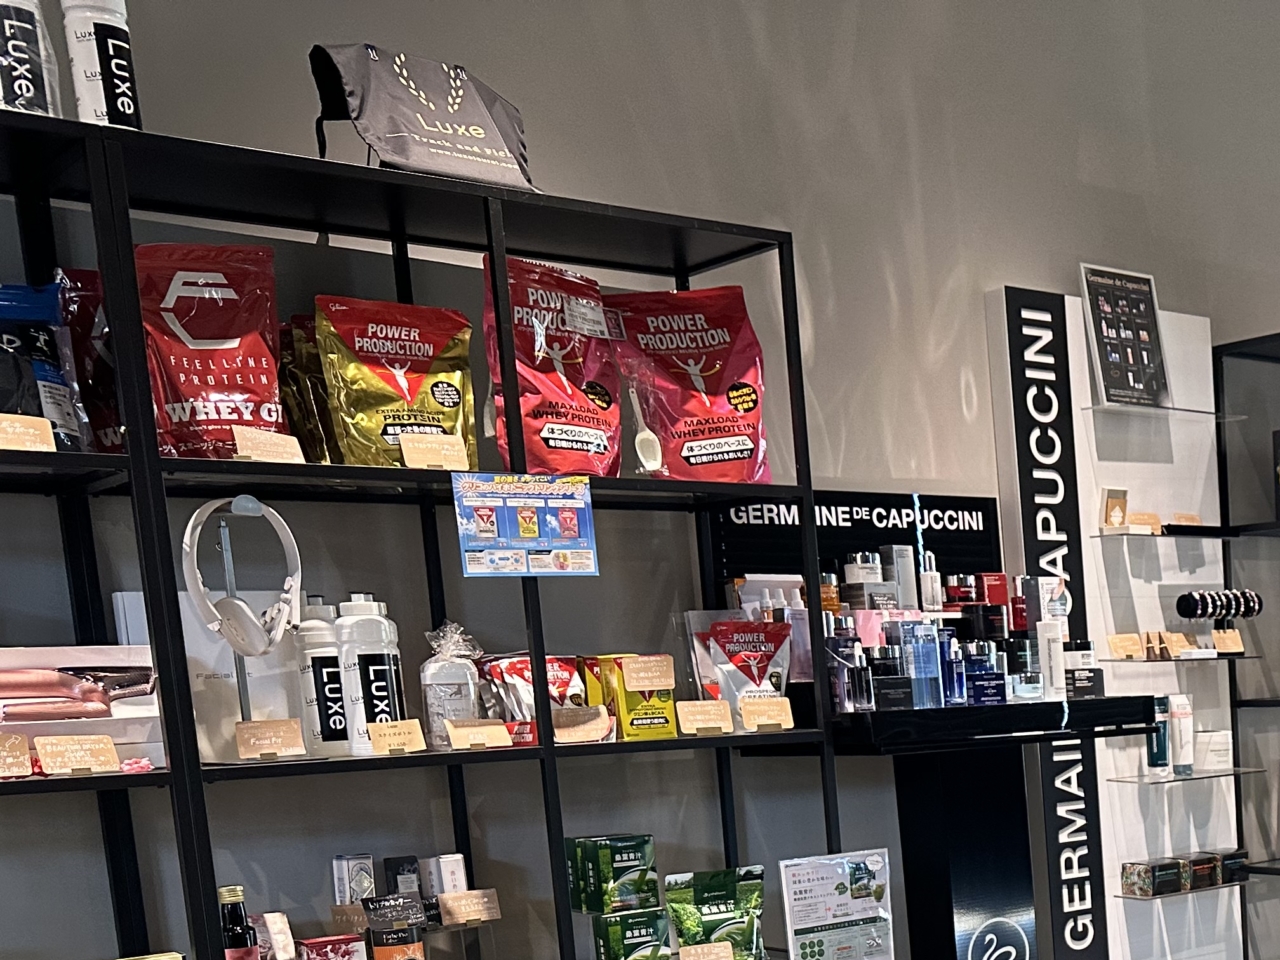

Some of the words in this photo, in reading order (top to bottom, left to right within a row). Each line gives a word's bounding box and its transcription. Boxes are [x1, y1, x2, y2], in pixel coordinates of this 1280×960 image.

[74, 30, 95, 39] Lux
[3, 19, 35, 98] Luxe
[107, 38, 135, 115] Luxe
[416, 112, 487, 139] Luxe
[410, 133, 452, 147] Track
[455, 142, 482, 153] and
[484, 148, 513, 159] Fiel
[1087, 273, 1115, 286] Germaine
[1115, 278, 1122, 287] de
[1122, 279, 1150, 292] Capuccini
[527, 287, 565, 310] POW
[514, 305, 569, 331] PRODUC
[646, 313, 709, 332] POWER
[368, 322, 420, 341] POWER
[637, 327, 731, 350] PRODUCTION
[354, 337, 434, 358] PRODUCTION
[179, 373, 269, 386] PROTEIN
[165, 401, 255, 423] WHEY
[548, 401, 599, 416] MAXLOAD
[383, 414, 442, 424] PROTEIN
[531, 409, 570, 420] WHEY
[571, 413, 612, 428] PROTEIN
[684, 416, 739, 428] MAXLOAD
[671, 427, 707, 440] WHEY
[707, 422, 756, 435] PROTEIN
[687, 439, 749, 454] 体づくりのベースに
[729, 503, 852, 528] GERMINE
[853, 506, 871, 520] DE
[871, 507, 984, 532] CAPUCCINI
[733, 633, 766, 643] POWER
[725, 642, 775, 653] PRODUCTION
[299, 663, 312, 672] Lux
[196, 671, 234, 680] Facial
[305, 696, 318, 704] Lux
[322, 667, 346, 730] Luxe
[513, 724, 530, 734] POWER
[250, 737, 271, 746] Facial
[271, 736, 283, 744] Fit
[64, 750, 92, 758] SMART
[614, 852, 642, 862] 桑葉青汁
[793, 888, 813, 896] 桑葉青汁
[701, 903, 735, 915] 桑葉青汁
[625, 927, 655, 938] 桑葉青汁
